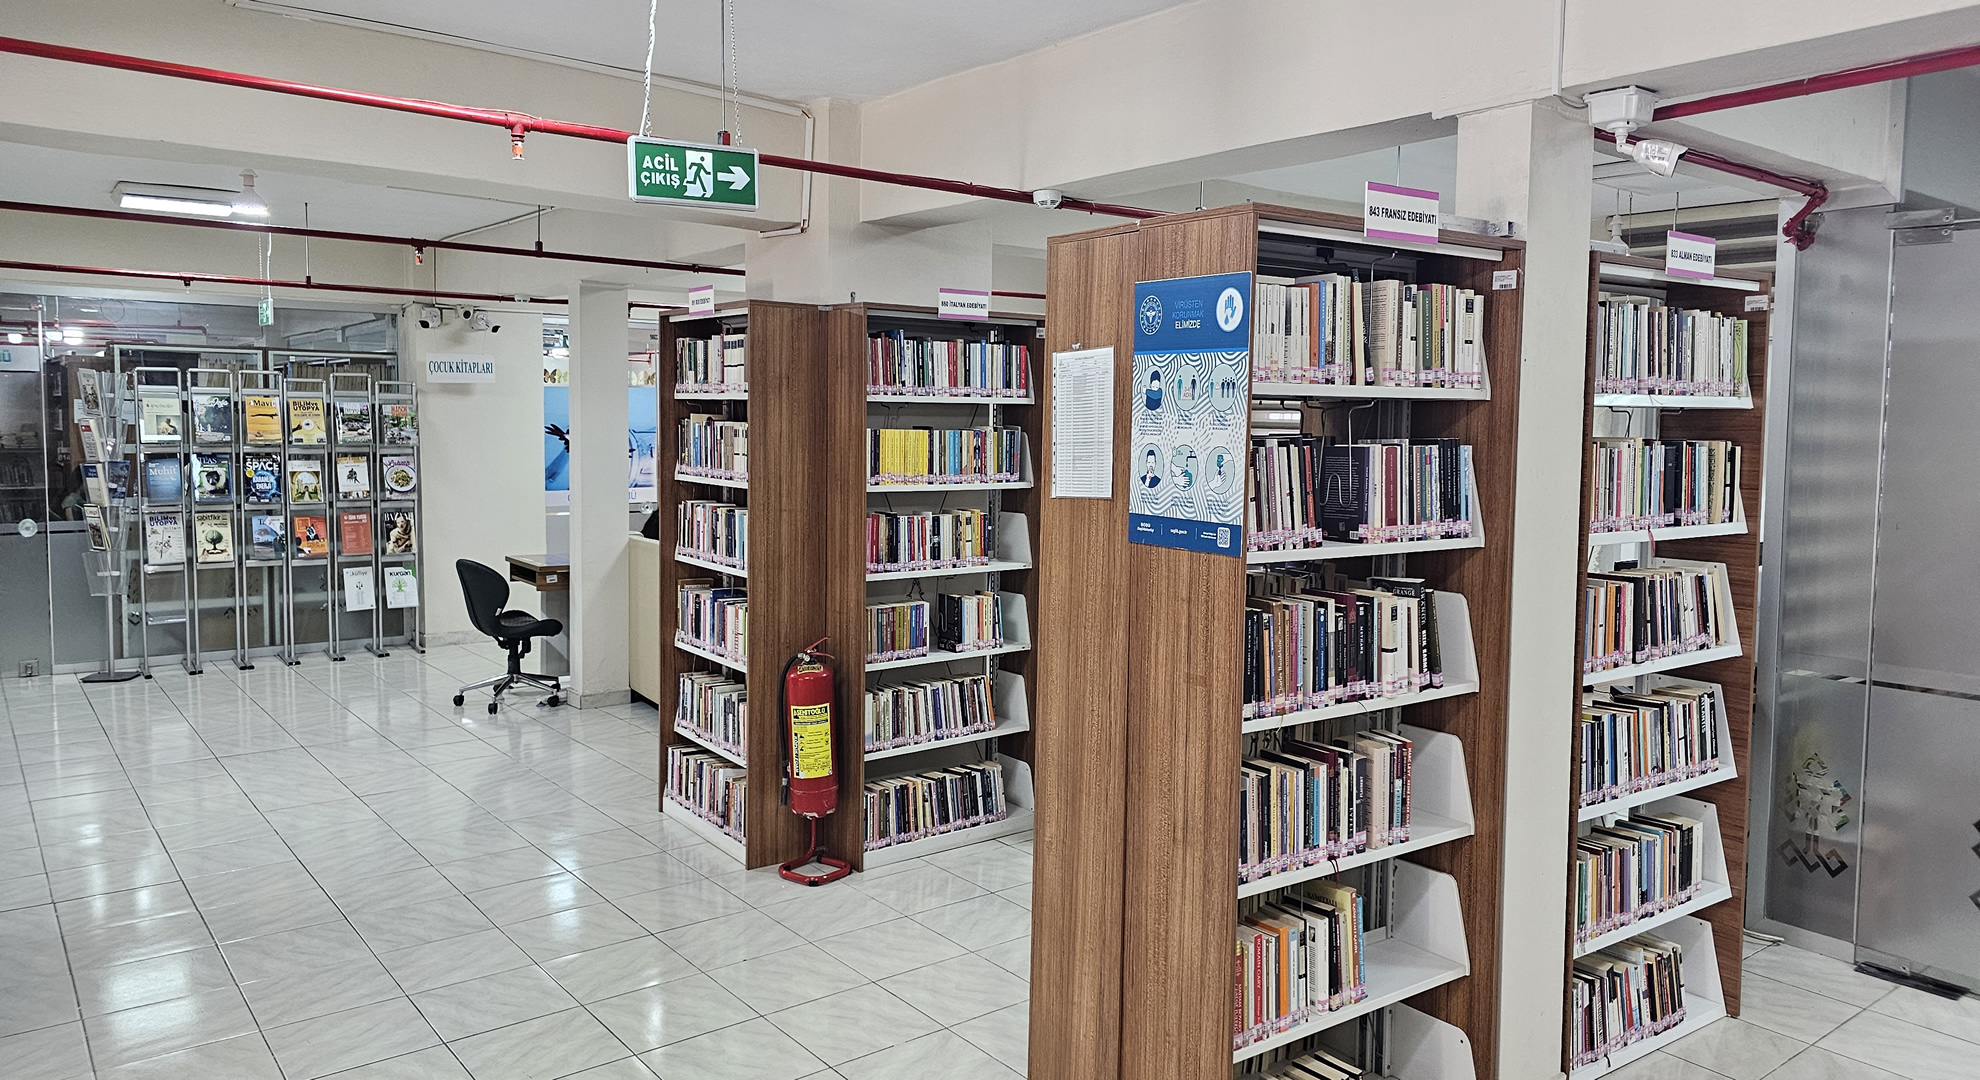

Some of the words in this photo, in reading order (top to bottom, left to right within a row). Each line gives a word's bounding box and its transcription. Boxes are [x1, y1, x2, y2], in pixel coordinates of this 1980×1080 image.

[642, 153, 678, 171] ACİL
[640, 172, 680, 189] ÇIKIŞ
[1369, 206, 1380, 217] 843
[1381, 208, 1406, 220] FRANSIZ
[1408, 210, 1436, 225] EDEBİYATI
[1175, 320, 1201, 329] ELİMİZDE
[428, 360, 454, 375] ÇOCUK
[456, 359, 493, 374] KİTAPLARI
[246, 461, 279, 470] SPACE
